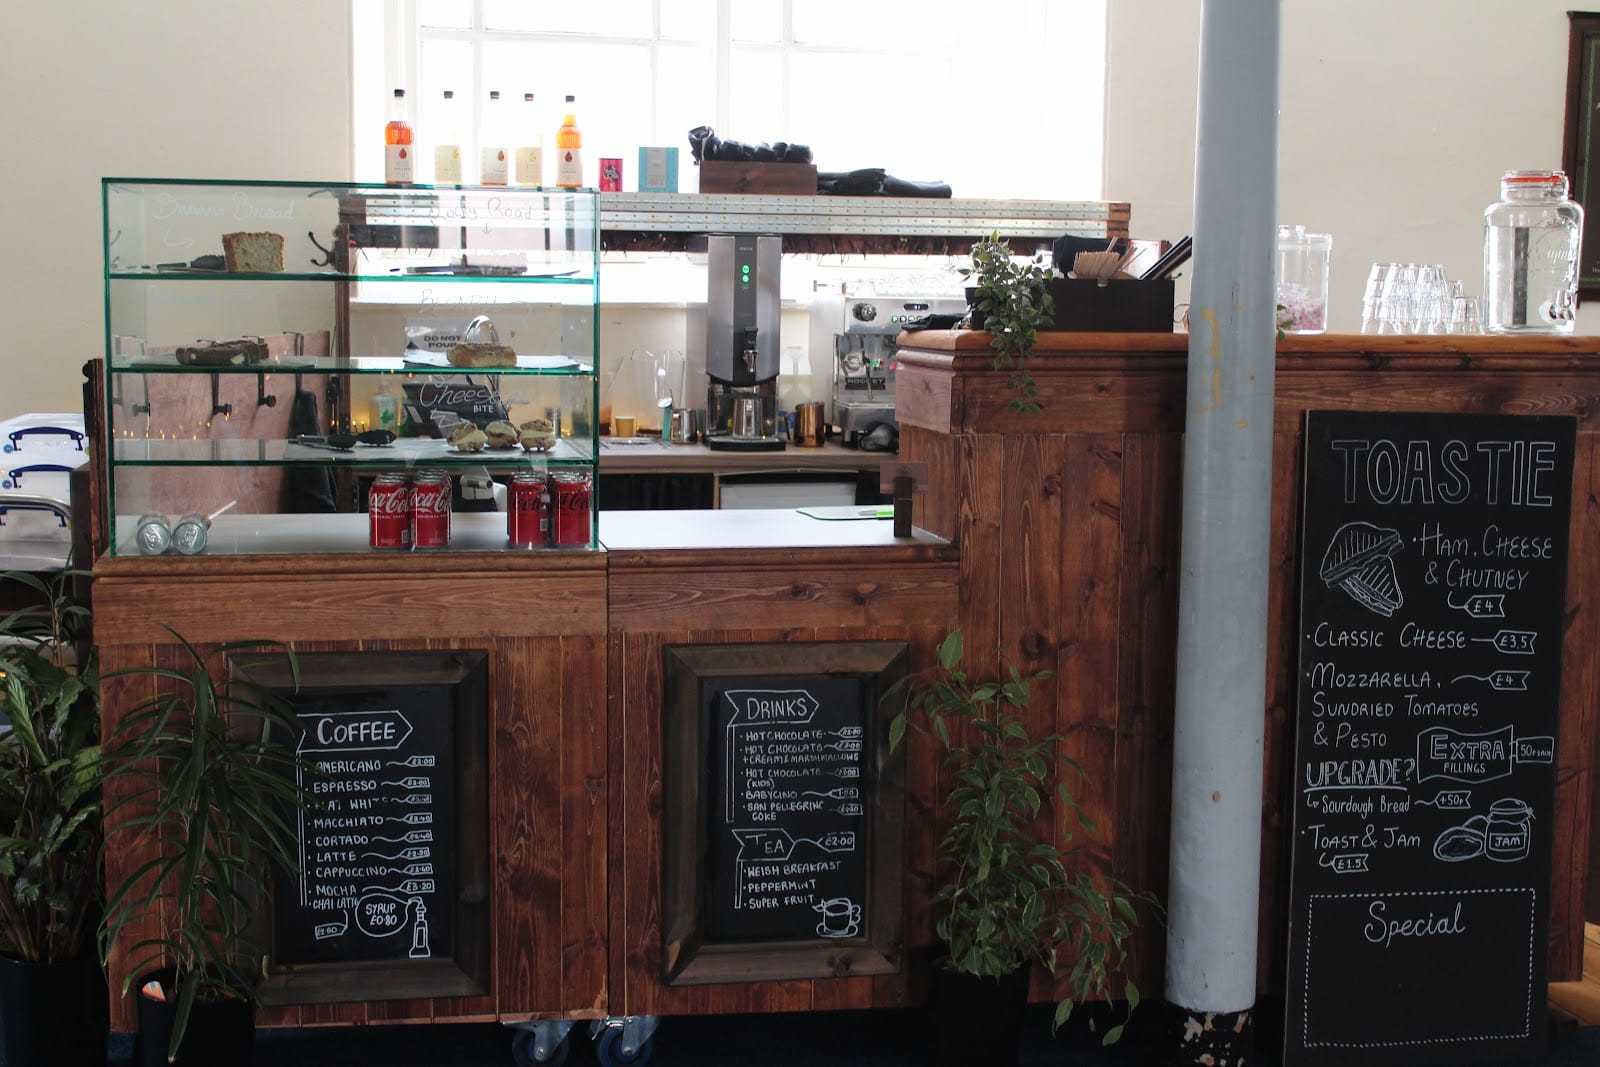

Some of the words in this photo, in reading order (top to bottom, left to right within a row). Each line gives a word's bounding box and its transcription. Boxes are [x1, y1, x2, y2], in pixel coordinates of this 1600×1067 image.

[232, 191, 294, 220] Bread
[429, 206, 479, 226] Rocky
[487, 197, 532, 220] Road
[420, 375, 501, 407] Cheese
[473, 404, 494, 413] BITE
[1332, 440, 1555, 506] TOASTIE
[1482, 525, 1552, 559] CHEESE
[1424, 561, 1439, 585] &
[1446, 559, 1529, 590] CHUTNEY
[1473, 600, 1494, 613] £4
[1314, 622, 1384, 647] CLASSIC
[1399, 622, 1466, 649] CHEESE
[1499, 635, 1528, 647] £3.5
[1495, 675, 1513, 686] £4
[746, 698, 808, 720] DRINKS
[1312, 691, 1394, 718] SUNDRIED
[1403, 694, 1479, 717] TOMATOES
[317, 718, 396, 745] COFFEE
[746, 731, 765, 741] HOT
[766, 730, 823, 740] CHOCOLATE
[1313, 722, 1329, 746] &
[1335, 722, 1387, 748] PESTO
[745, 744, 764, 754] HOT
[767, 743, 823, 754] CHOCOLATE
[1430, 734, 1505, 760] EXTRA
[315, 760, 381, 774] AMERICANO
[745, 768, 764, 778] HOT
[767, 768, 822, 778] CHOCOLATE
[1306, 758, 1416, 787] UPGRADE?
[1443, 762, 1486, 774] FILLINGS
[313, 780, 377, 793] ESPRESSO
[746, 778, 775, 790] (KIDS)
[745, 790, 798, 800] BABYCINO
[315, 800, 341, 811] AT
[747, 802, 767, 812] SAN
[1322, 795, 1374, 819] Sourdough
[1379, 794, 1410, 813] Bread
[313, 816, 384, 829] MACCHIATO
[752, 811, 777, 821] COKE
[315, 835, 369, 846] CORTADO
[745, 832, 785, 854] TEA
[1308, 824, 1358, 849] TOAST
[1361, 824, 1377, 848] &
[1383, 827, 1421, 849] JAM
[1494, 836, 1521, 847] JAM
[316, 851, 357, 863] LATTE
[1336, 858, 1362, 869] £1.5
[315, 866, 387, 878] CAPPUCCINO
[783, 861, 841, 876] BREAKFAST
[315, 884, 357, 897] MOCHA
[748, 879, 816, 893] PEPPERMINT
[312, 898, 334, 911] CHAI
[749, 898, 779, 909] SUPER
[783, 894, 814, 906] FRUIT
[365, 902, 396, 915] SYRUP
[1364, 901, 1465, 948] Special
